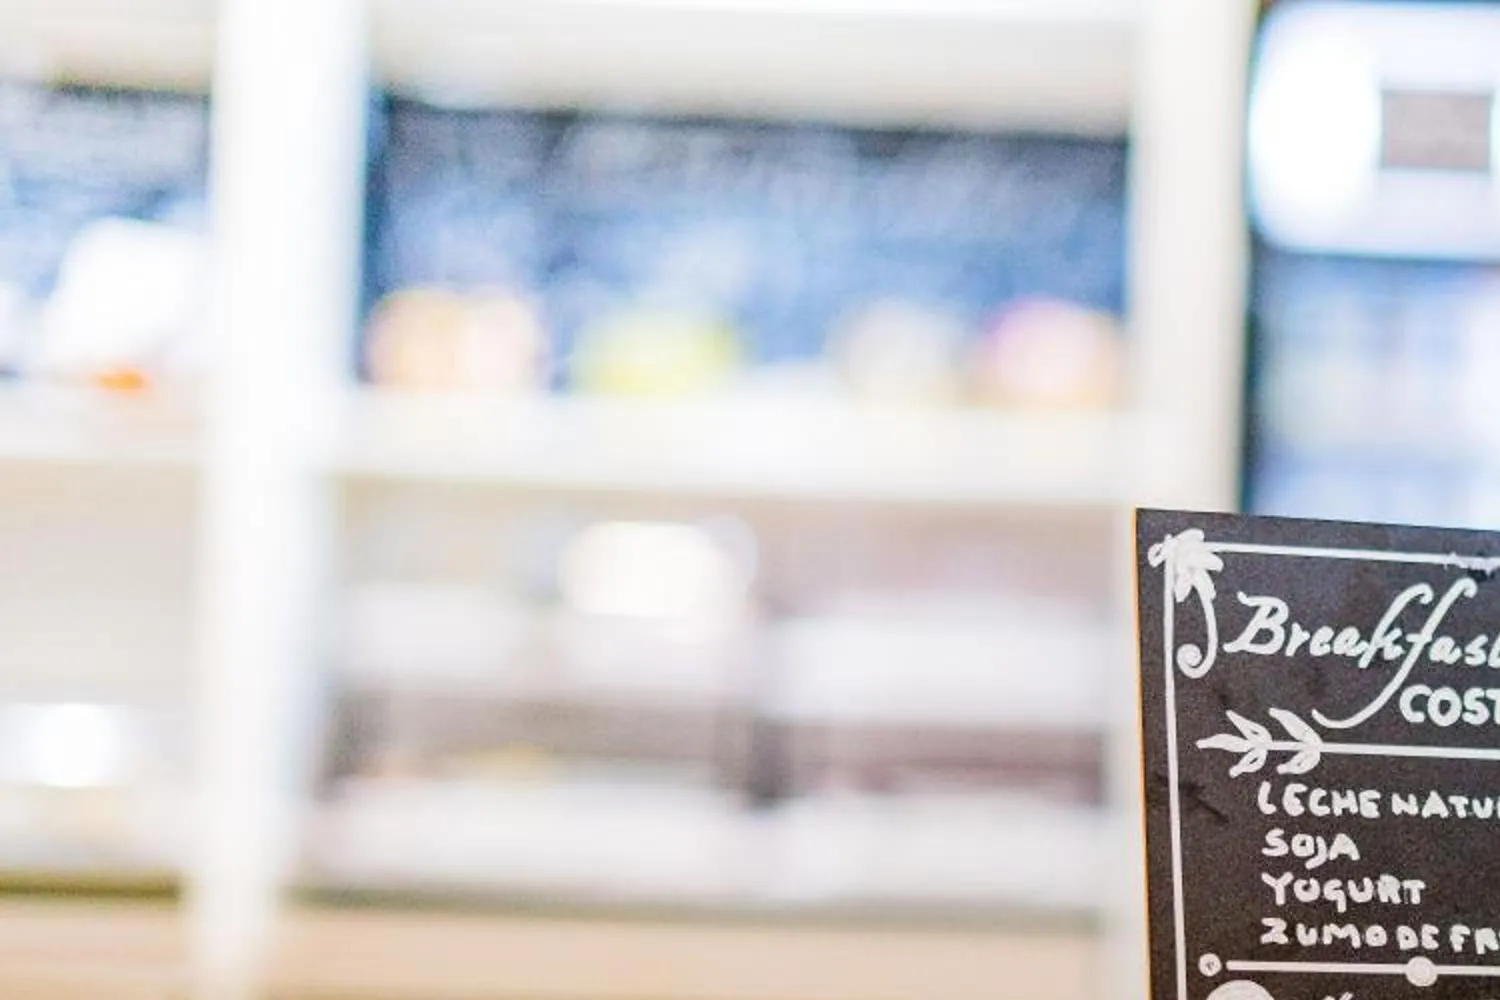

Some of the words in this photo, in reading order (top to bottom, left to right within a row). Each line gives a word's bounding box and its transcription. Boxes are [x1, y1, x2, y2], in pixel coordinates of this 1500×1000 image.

[1257, 781, 1381, 820] LECHE
[1262, 830, 1361, 869] SOJA
[1262, 874, 1425, 911] YOGURT
[1260, 917, 1392, 950] ZUMO
[1397, 924, 1441, 951] DE
